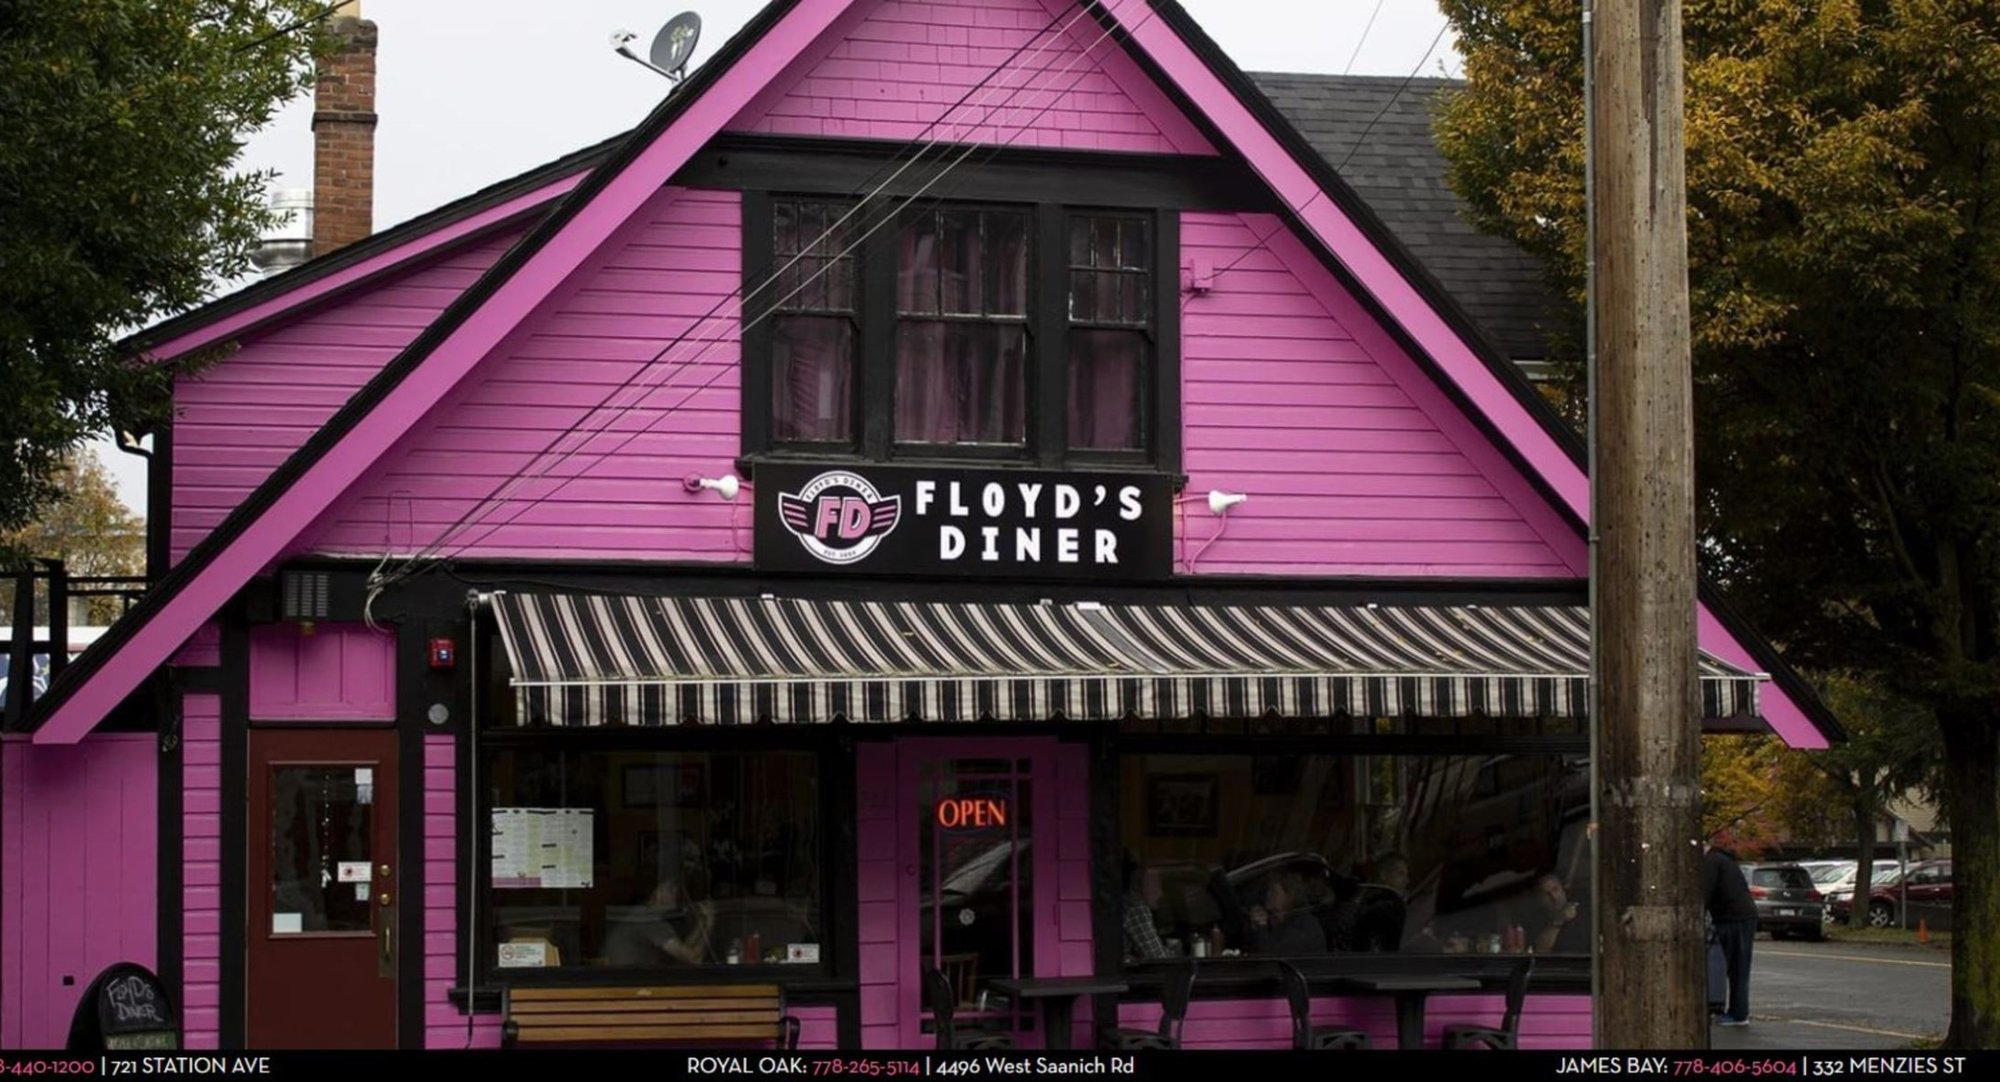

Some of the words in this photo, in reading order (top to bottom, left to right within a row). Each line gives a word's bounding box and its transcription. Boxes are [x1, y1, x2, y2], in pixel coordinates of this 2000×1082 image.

[814, 496, 872, 539] FD
[916, 480, 1142, 520] FLOYD'S
[940, 525, 1118, 564] DINER
[938, 800, 1006, 827] OPEN
